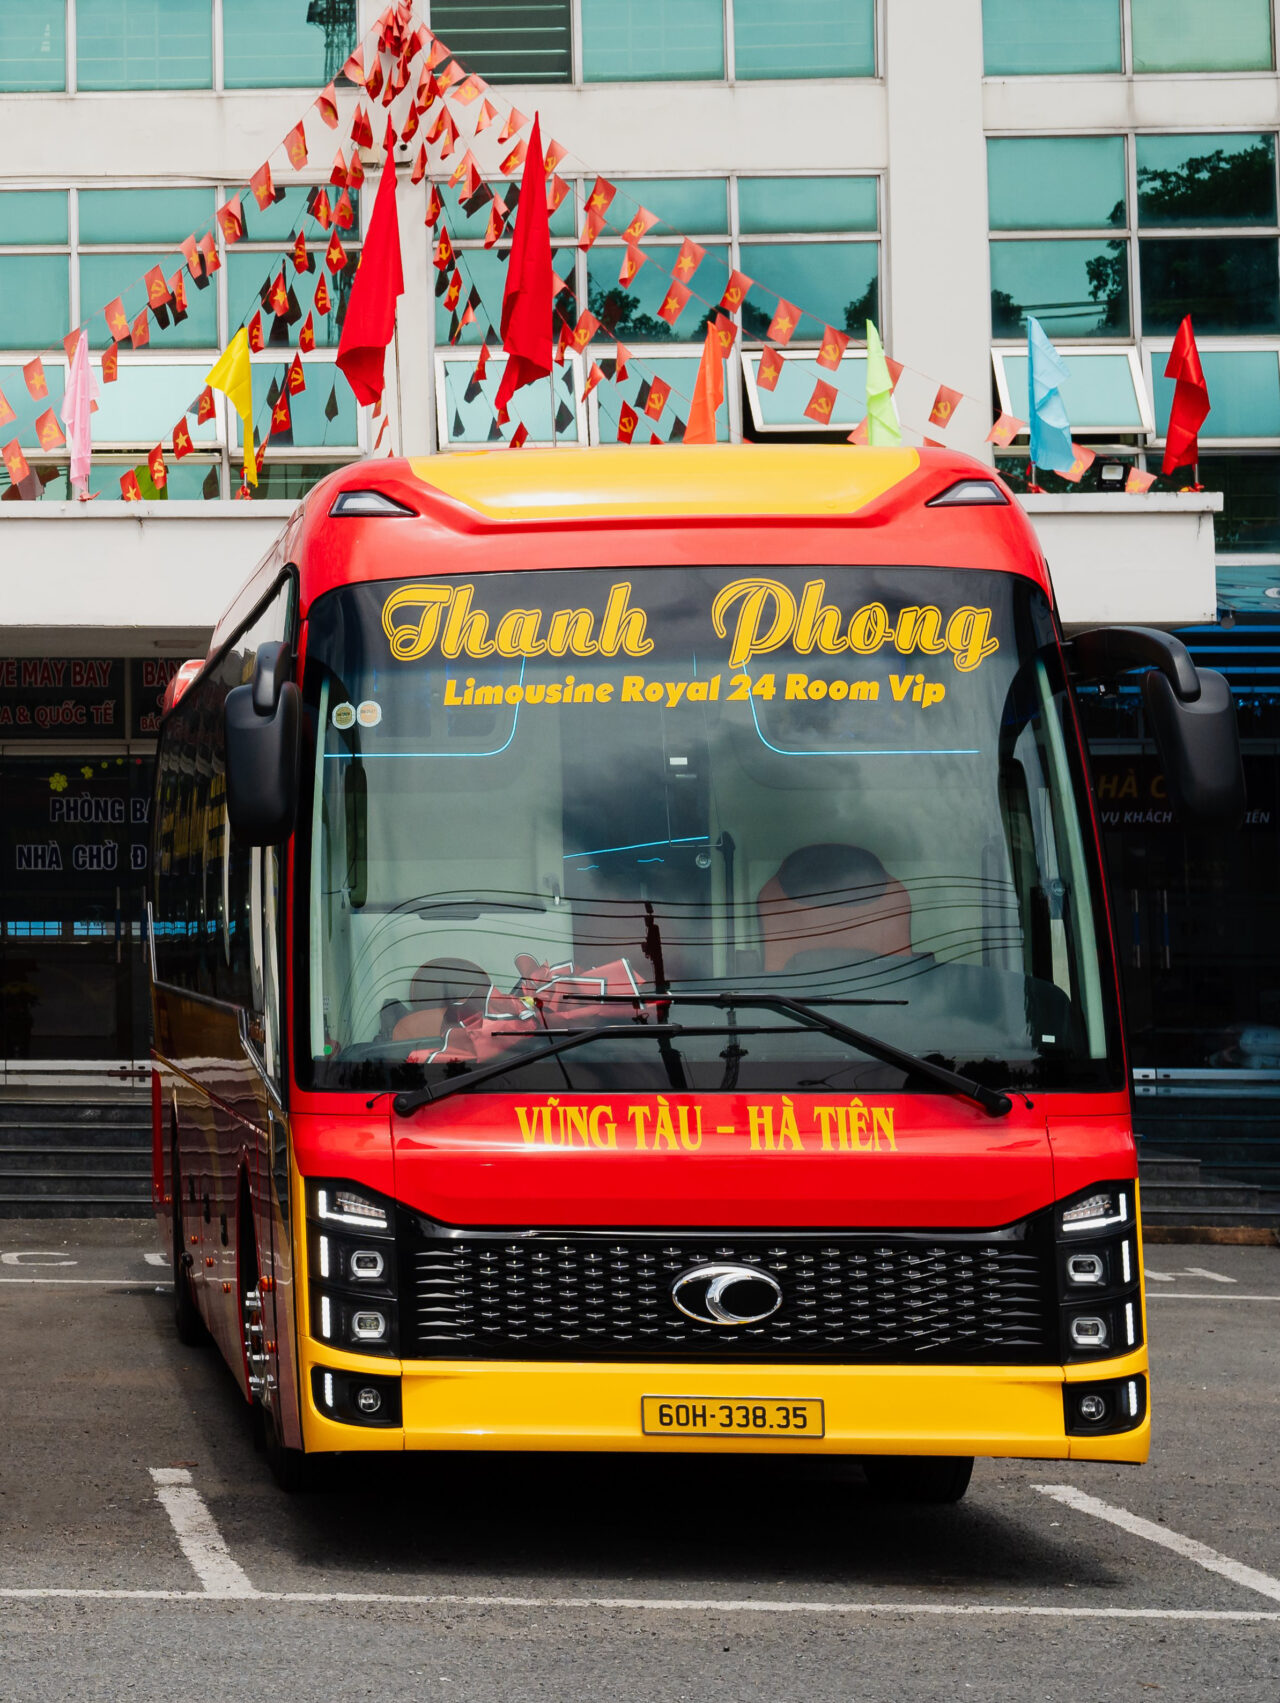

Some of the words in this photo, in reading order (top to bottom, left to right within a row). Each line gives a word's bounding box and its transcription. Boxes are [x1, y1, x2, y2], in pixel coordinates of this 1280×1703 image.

[382, 581, 654, 662] Thanh
[712, 578, 1000, 673] Phong
[22, 657, 66, 687] MÁY
[71, 661, 112, 687] BAY
[443, 676, 612, 707] Limousine
[620, 674, 720, 709] Royal
[725, 673, 776, 702] 24
[785, 673, 880, 702] Room
[889, 674, 946, 709] Vip
[35, 702, 87, 728] QUỐC
[92, 700, 116, 724] TẾ
[49, 792, 124, 823] PHÒNG
[16, 840, 62, 870] NHÀ
[73, 839, 118, 870] CHỜ
[515, 1096, 618, 1150] VŨNG
[627, 1095, 702, 1151] TÀU
[747, 1095, 805, 1152] HÀ
[813, 1097, 898, 1152] TIÊN
[658, 1403, 808, 1429] 60H-338.35
